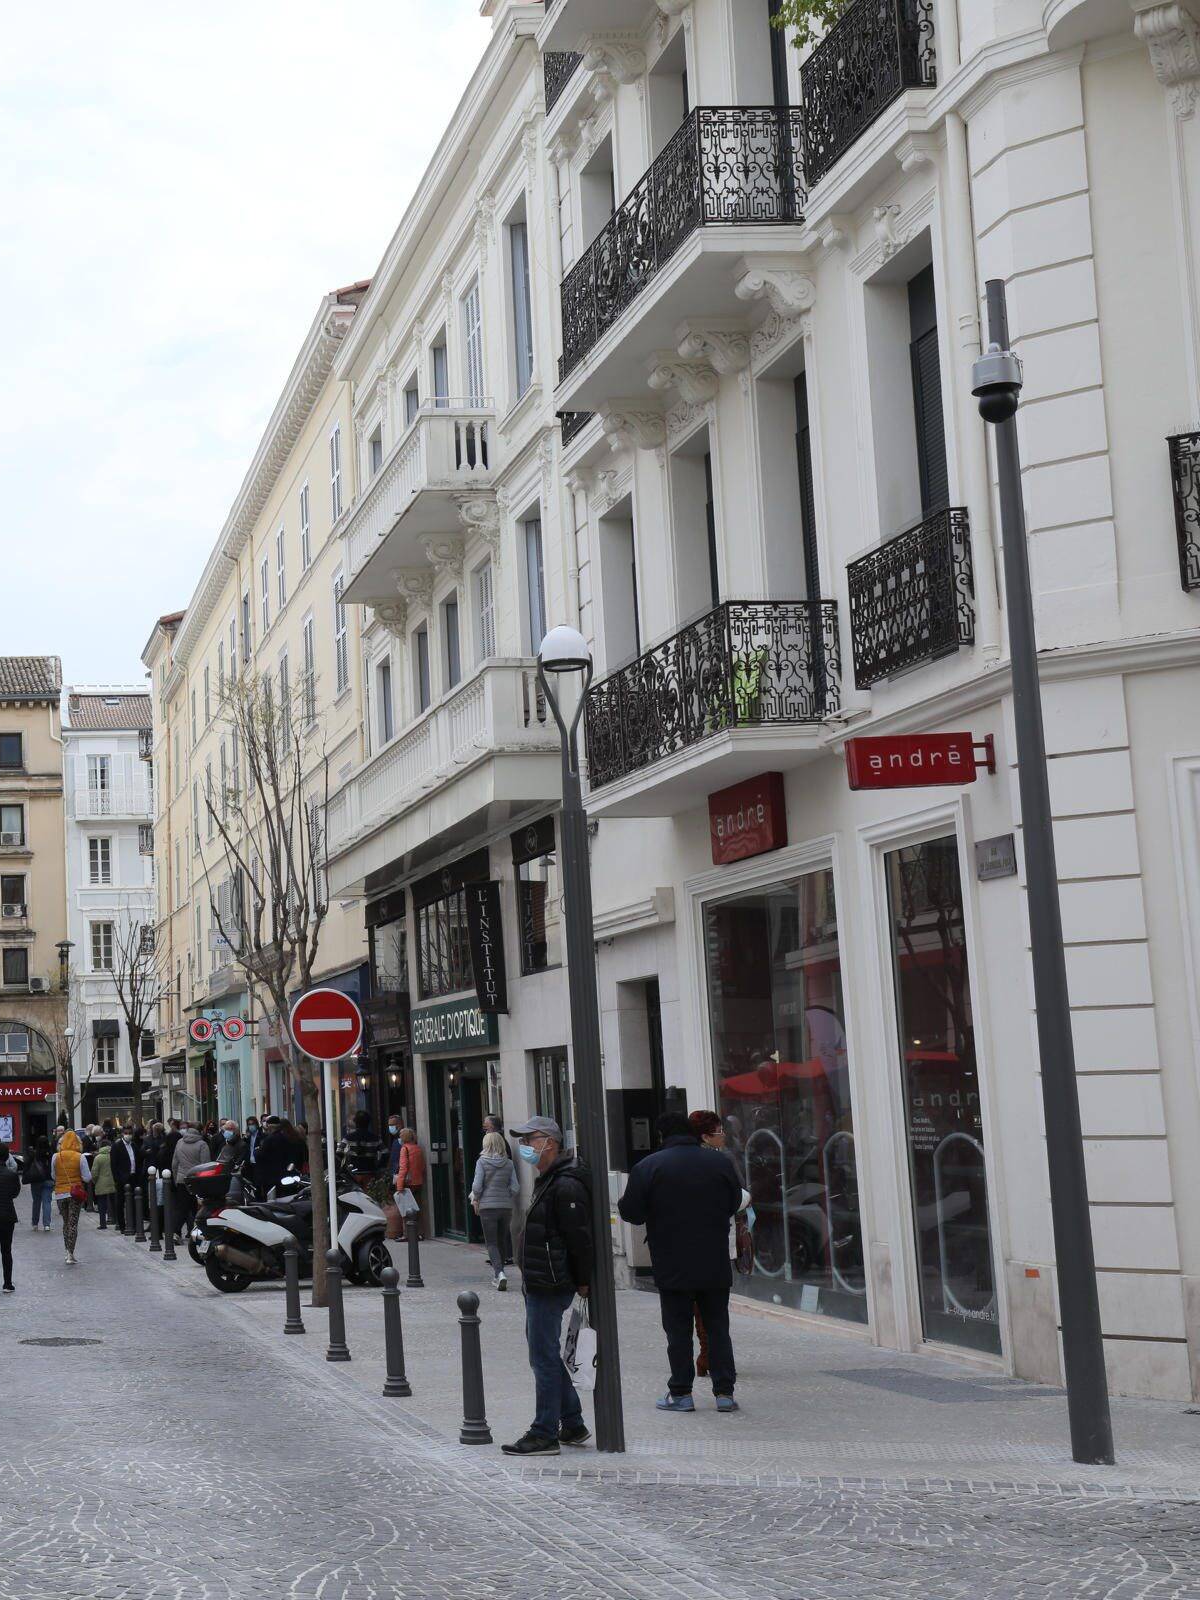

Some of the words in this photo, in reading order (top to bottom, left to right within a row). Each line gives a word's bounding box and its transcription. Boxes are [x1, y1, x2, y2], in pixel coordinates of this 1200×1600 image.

[477, 889, 498, 1006] L'INSTITUT
[413, 1011, 446, 1045] GÉNÉRALE
[447, 1008, 485, 1040] D'OPTIQUE
